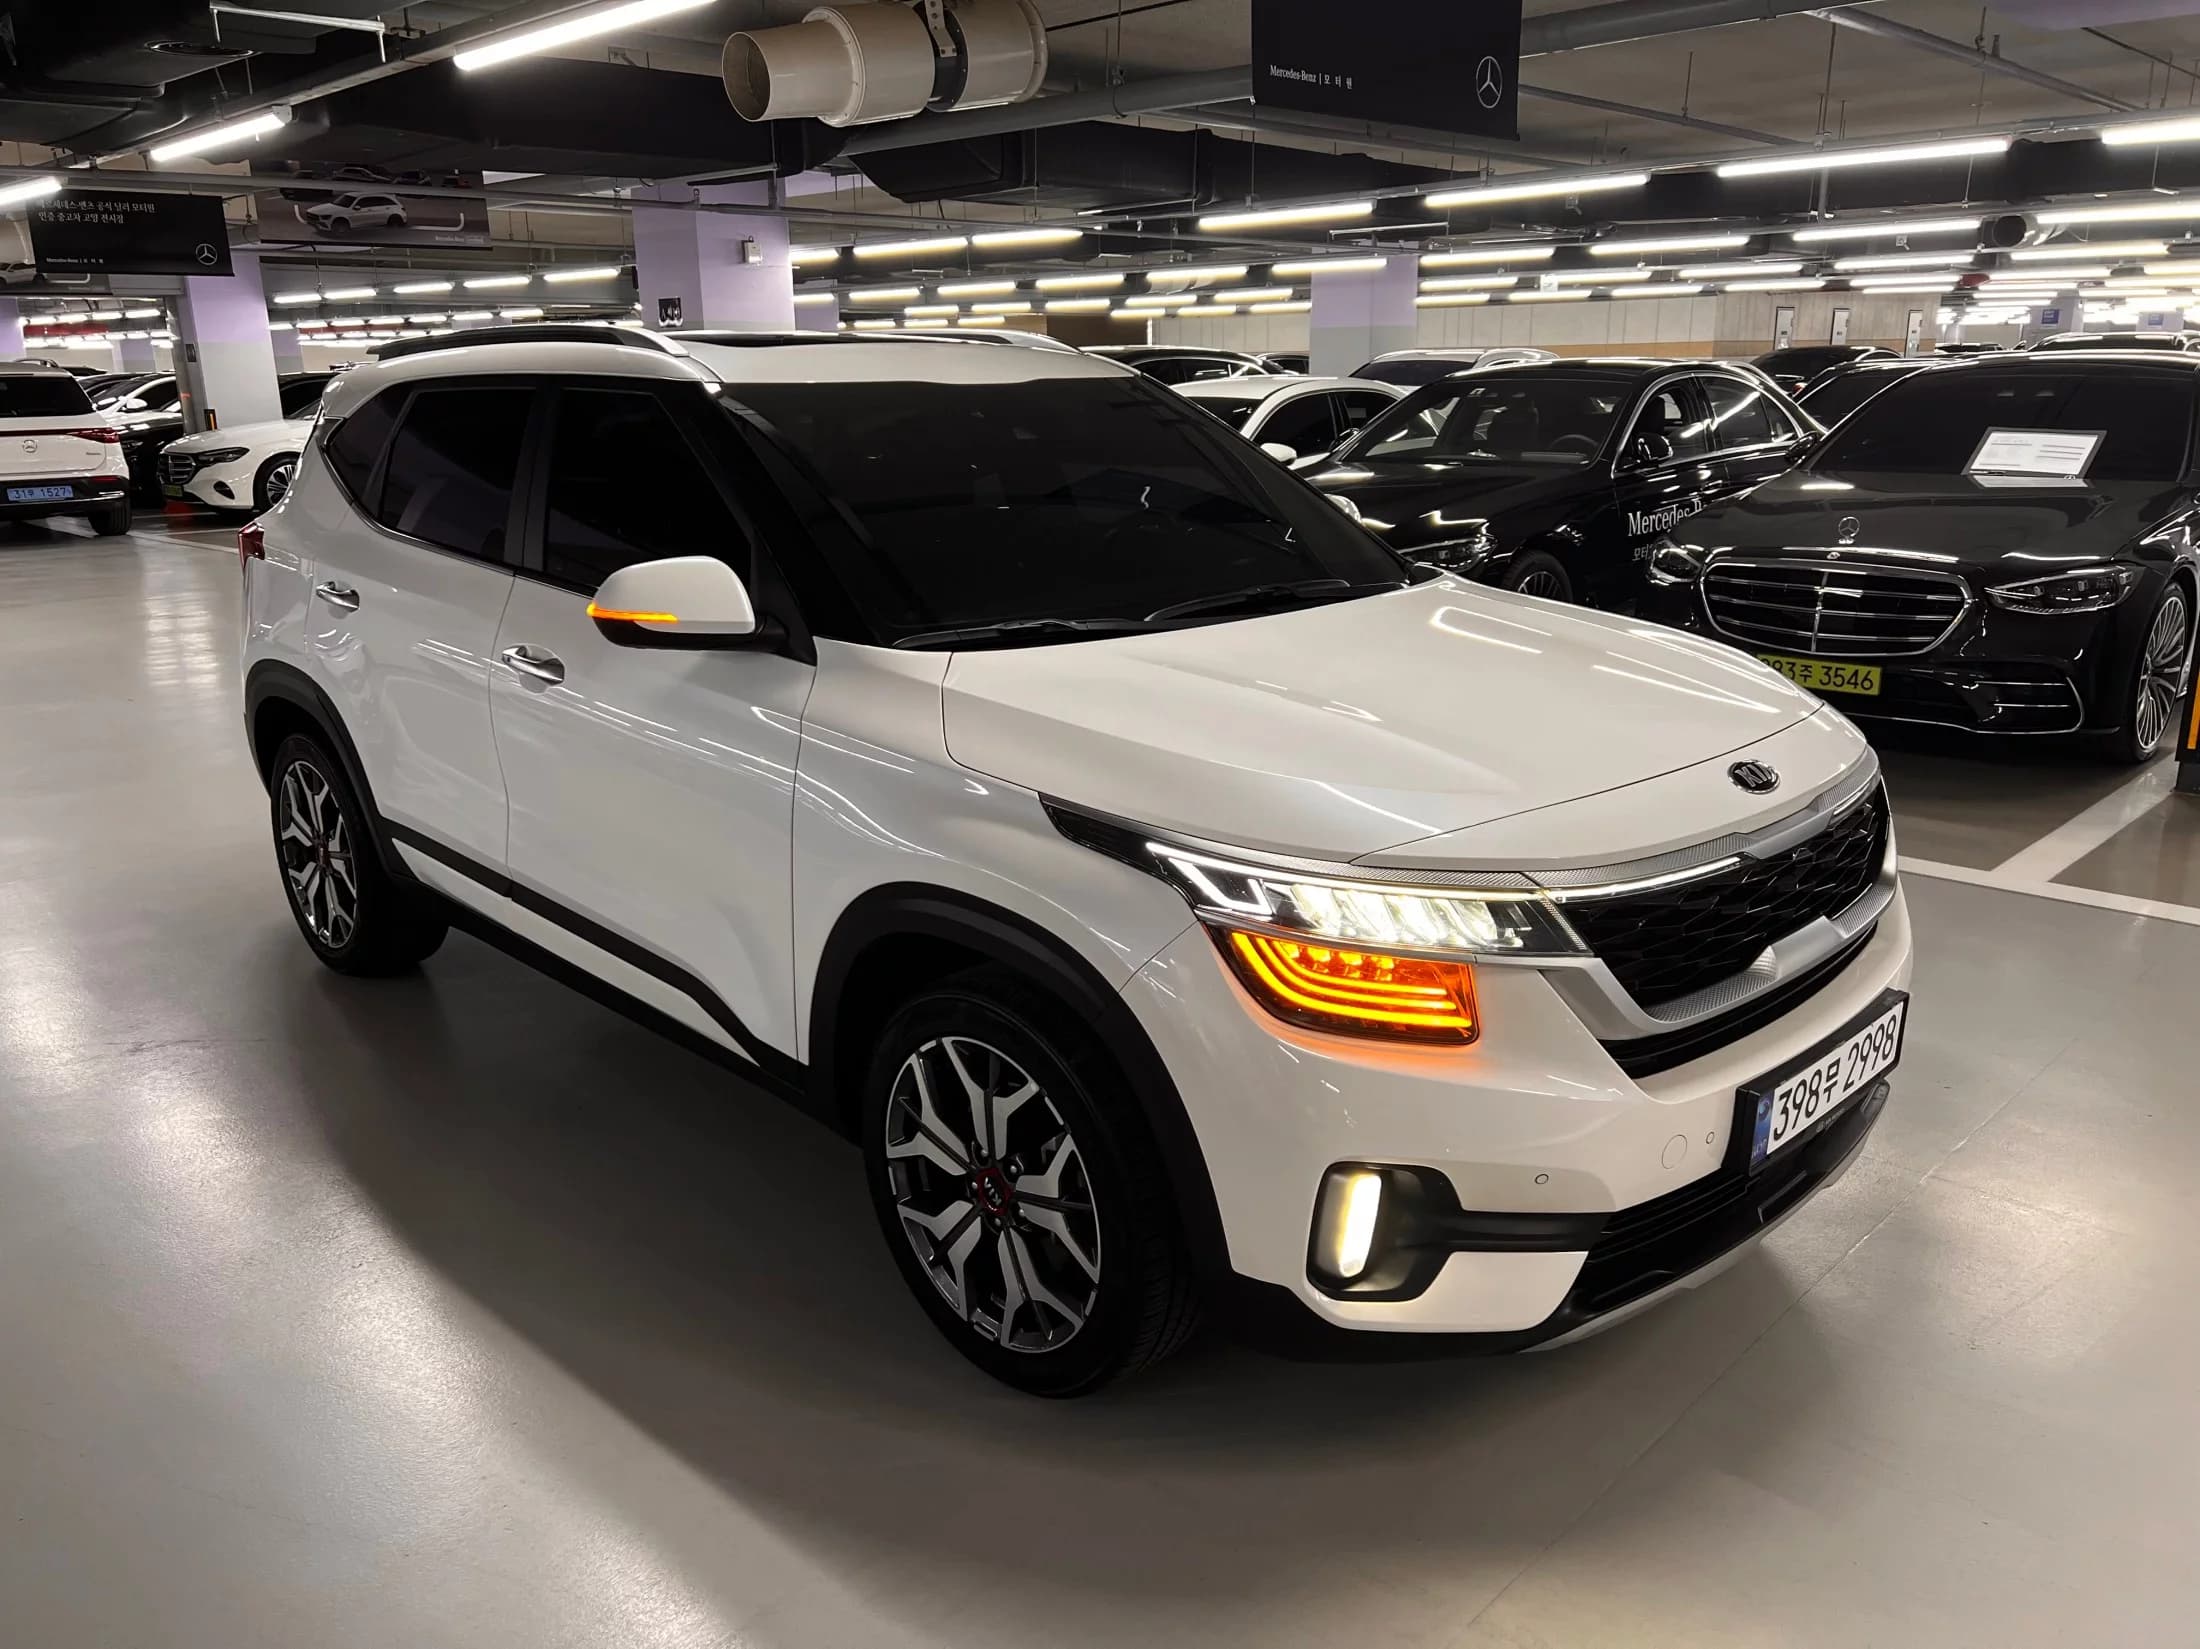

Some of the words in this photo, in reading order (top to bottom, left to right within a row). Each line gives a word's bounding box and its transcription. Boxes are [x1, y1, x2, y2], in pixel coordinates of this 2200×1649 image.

[1270, 64, 1317, 83] Mercedes-Benz
[1819, 665, 1874, 691] 3546
[1773, 1056, 1841, 1141] 398무
[1842, 1014, 1897, 1093] 2998
